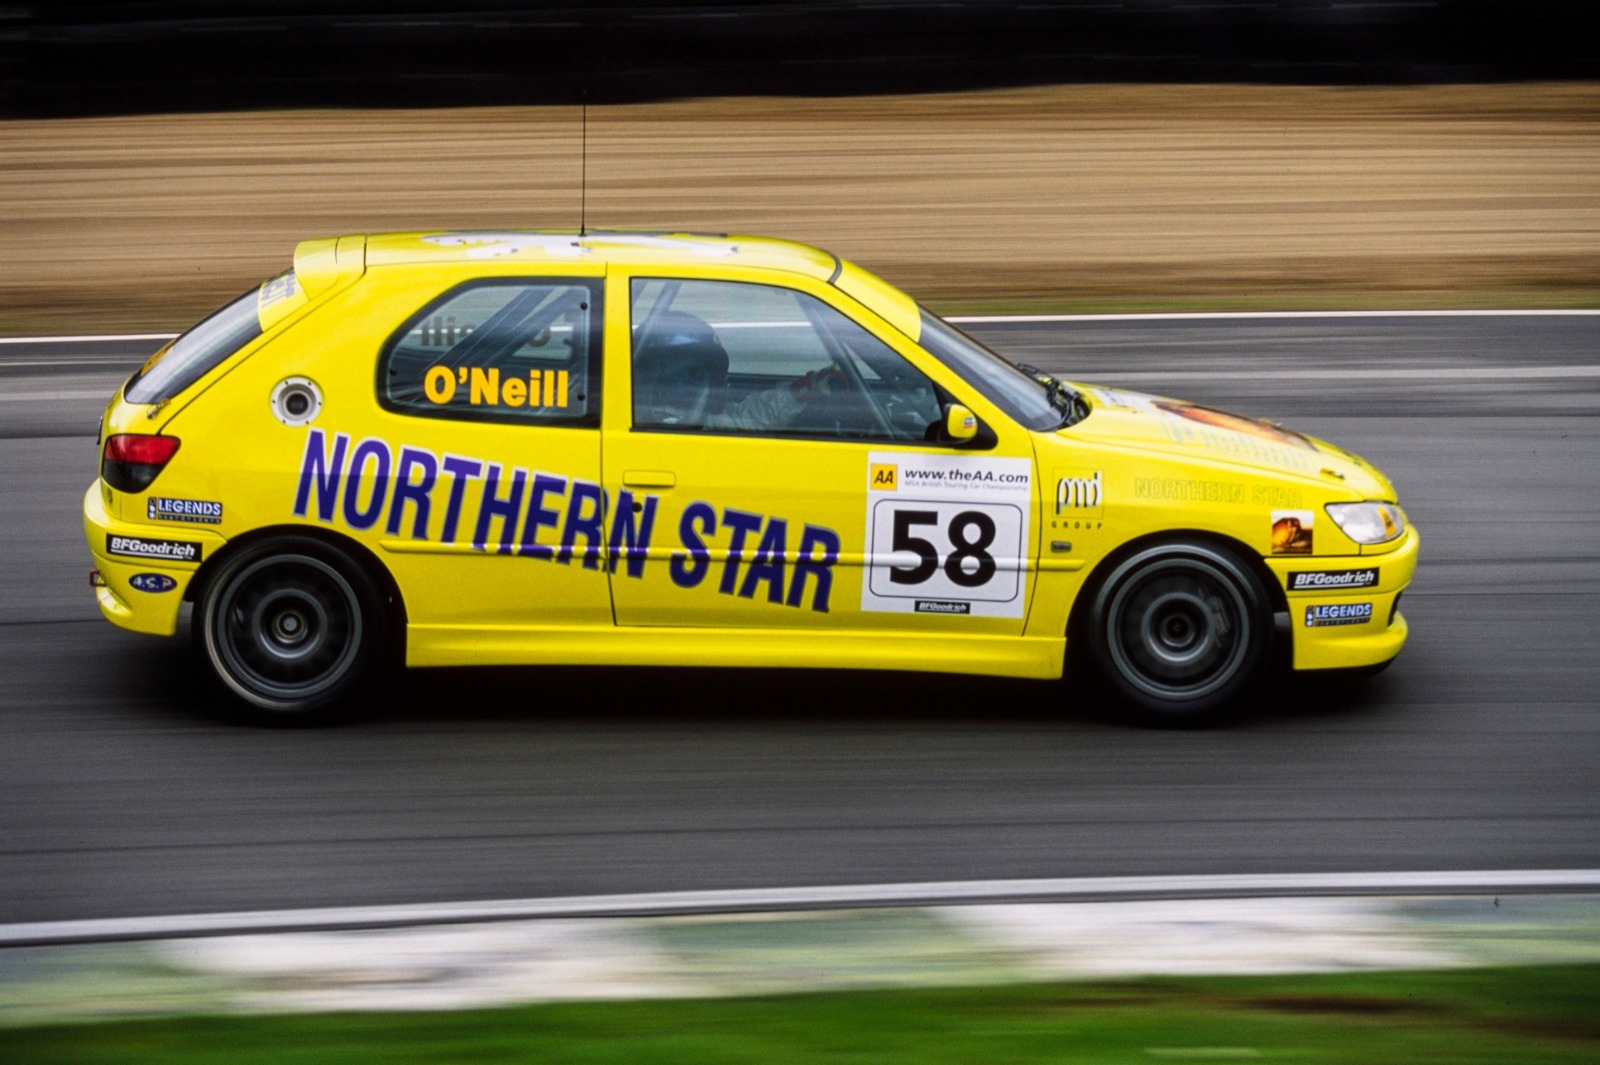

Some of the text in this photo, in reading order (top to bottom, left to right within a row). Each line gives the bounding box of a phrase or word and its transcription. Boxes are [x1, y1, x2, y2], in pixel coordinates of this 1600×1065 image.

[424, 365, 569, 408] O'Neill
[874, 469, 894, 484] AA
[904, 468, 1029, 484] www.theAA.com
[1134, 477, 1303, 509] NORTHERN STAR
[157, 498, 221, 516] LEGENDS
[293, 428, 842, 614] NORTHERN STAR
[1051, 520, 1102, 530] GROUP
[110, 536, 196, 557] BFGoodrich
[889, 509, 997, 588] 58
[1294, 570, 1375, 586] BFGoodrich
[918, 601, 967, 612] BFGoodrich
[1315, 603, 1372, 619] LEGENDS
